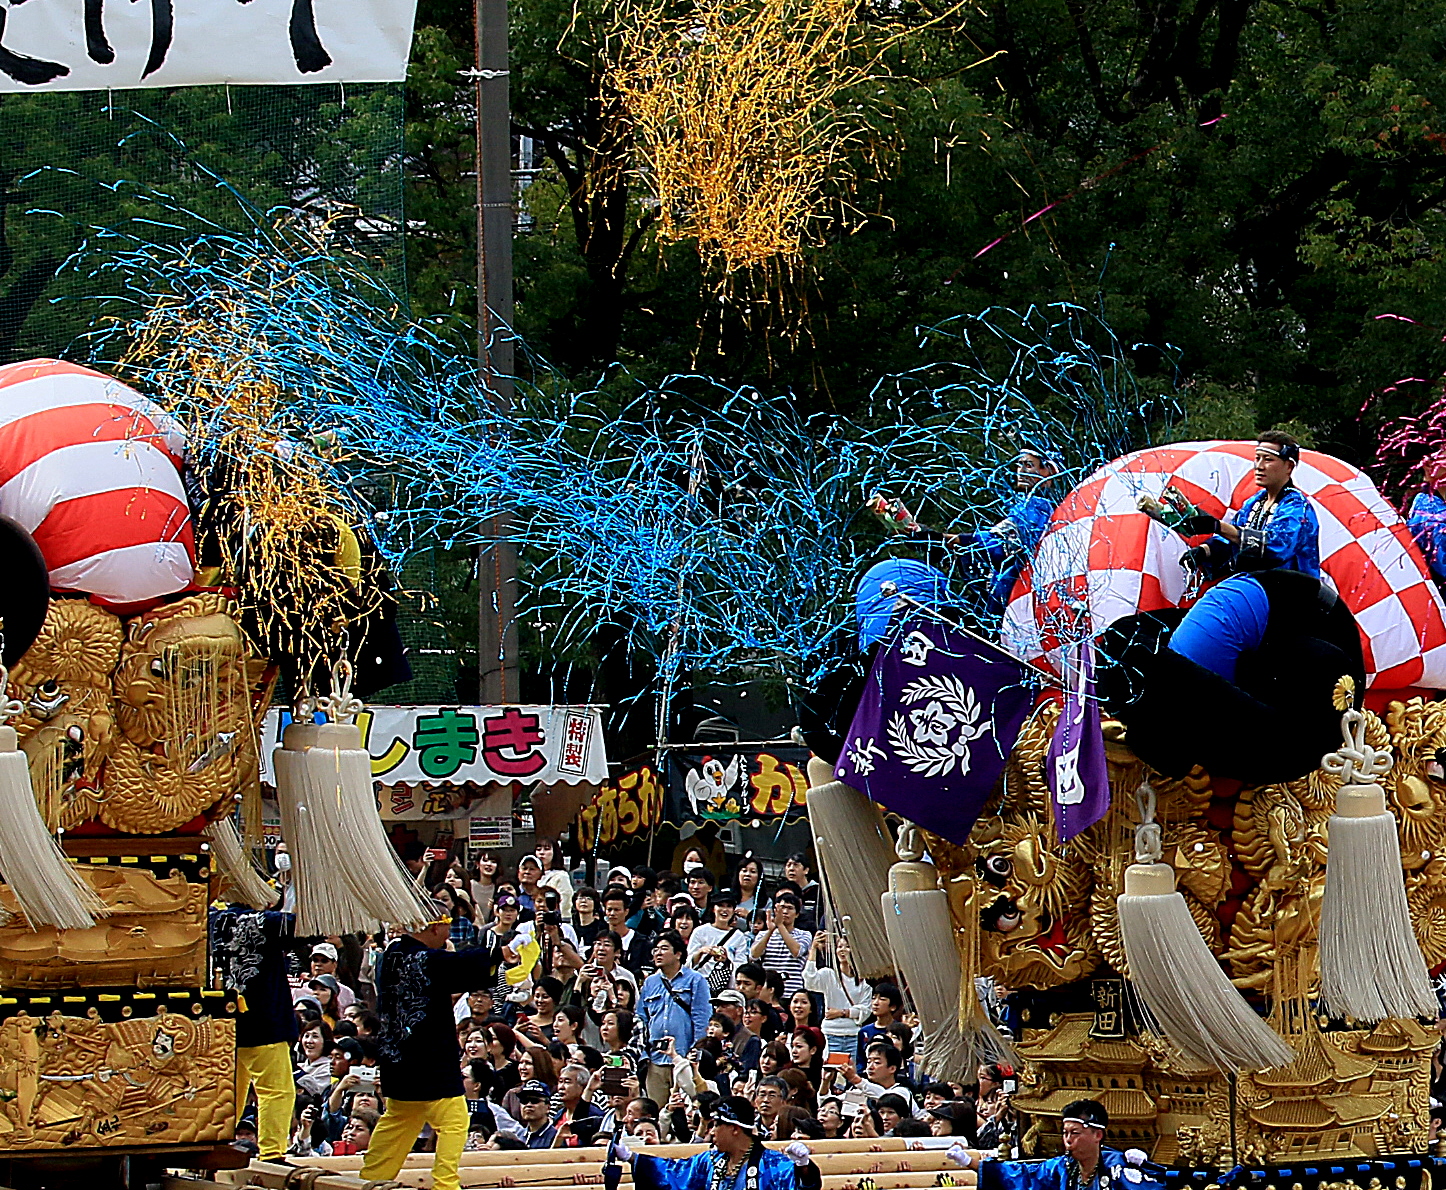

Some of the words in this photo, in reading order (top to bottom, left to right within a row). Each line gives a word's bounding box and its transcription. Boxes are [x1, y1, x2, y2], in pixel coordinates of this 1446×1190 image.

[281, 708, 547, 778] しまき
[1097, 986, 1118, 1031] 新田
